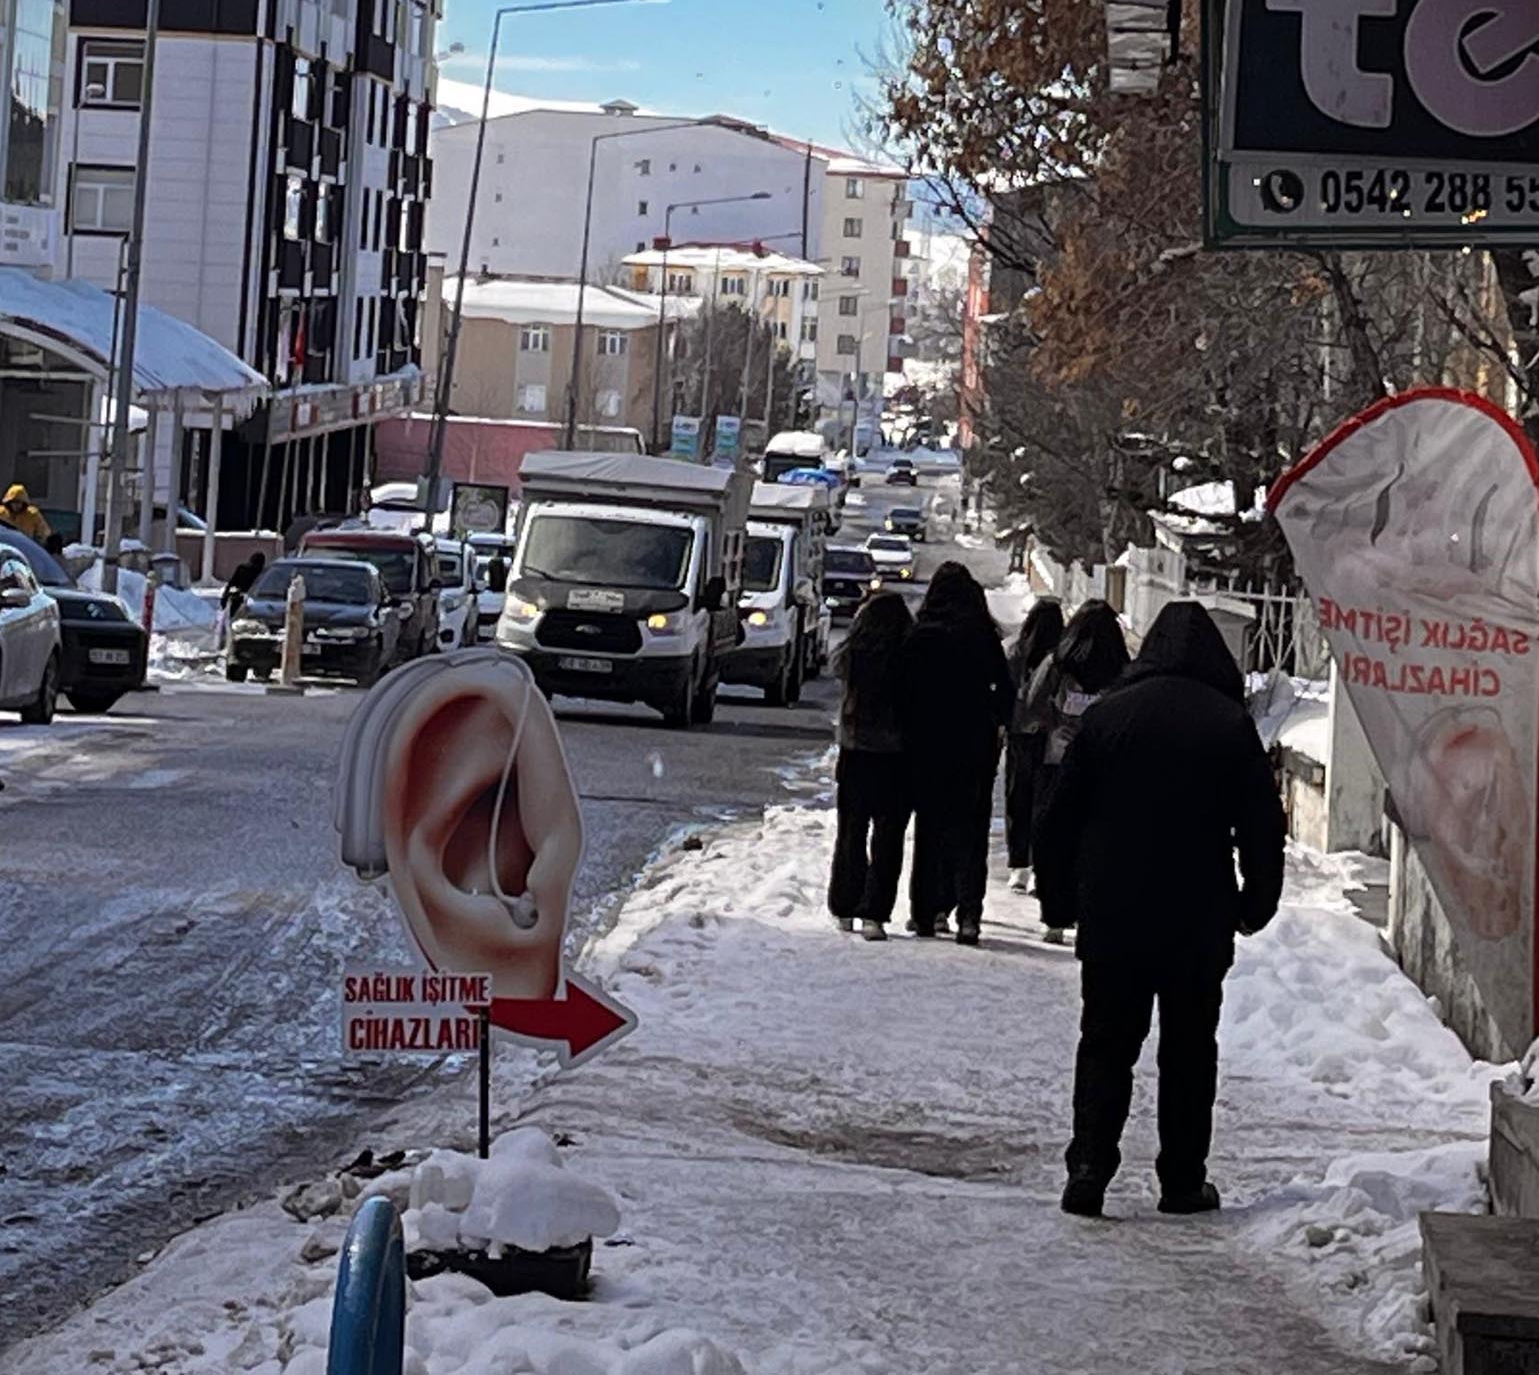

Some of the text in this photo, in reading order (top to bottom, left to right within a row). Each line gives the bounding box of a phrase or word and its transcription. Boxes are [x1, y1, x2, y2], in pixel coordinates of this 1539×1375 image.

[1320, 169, 1411, 214] 0542
[1424, 171, 1492, 214] 288
[344, 971, 490, 1006] SAĞLIK İŞİTME
[349, 1009, 481, 1051] CİHAZLARI
